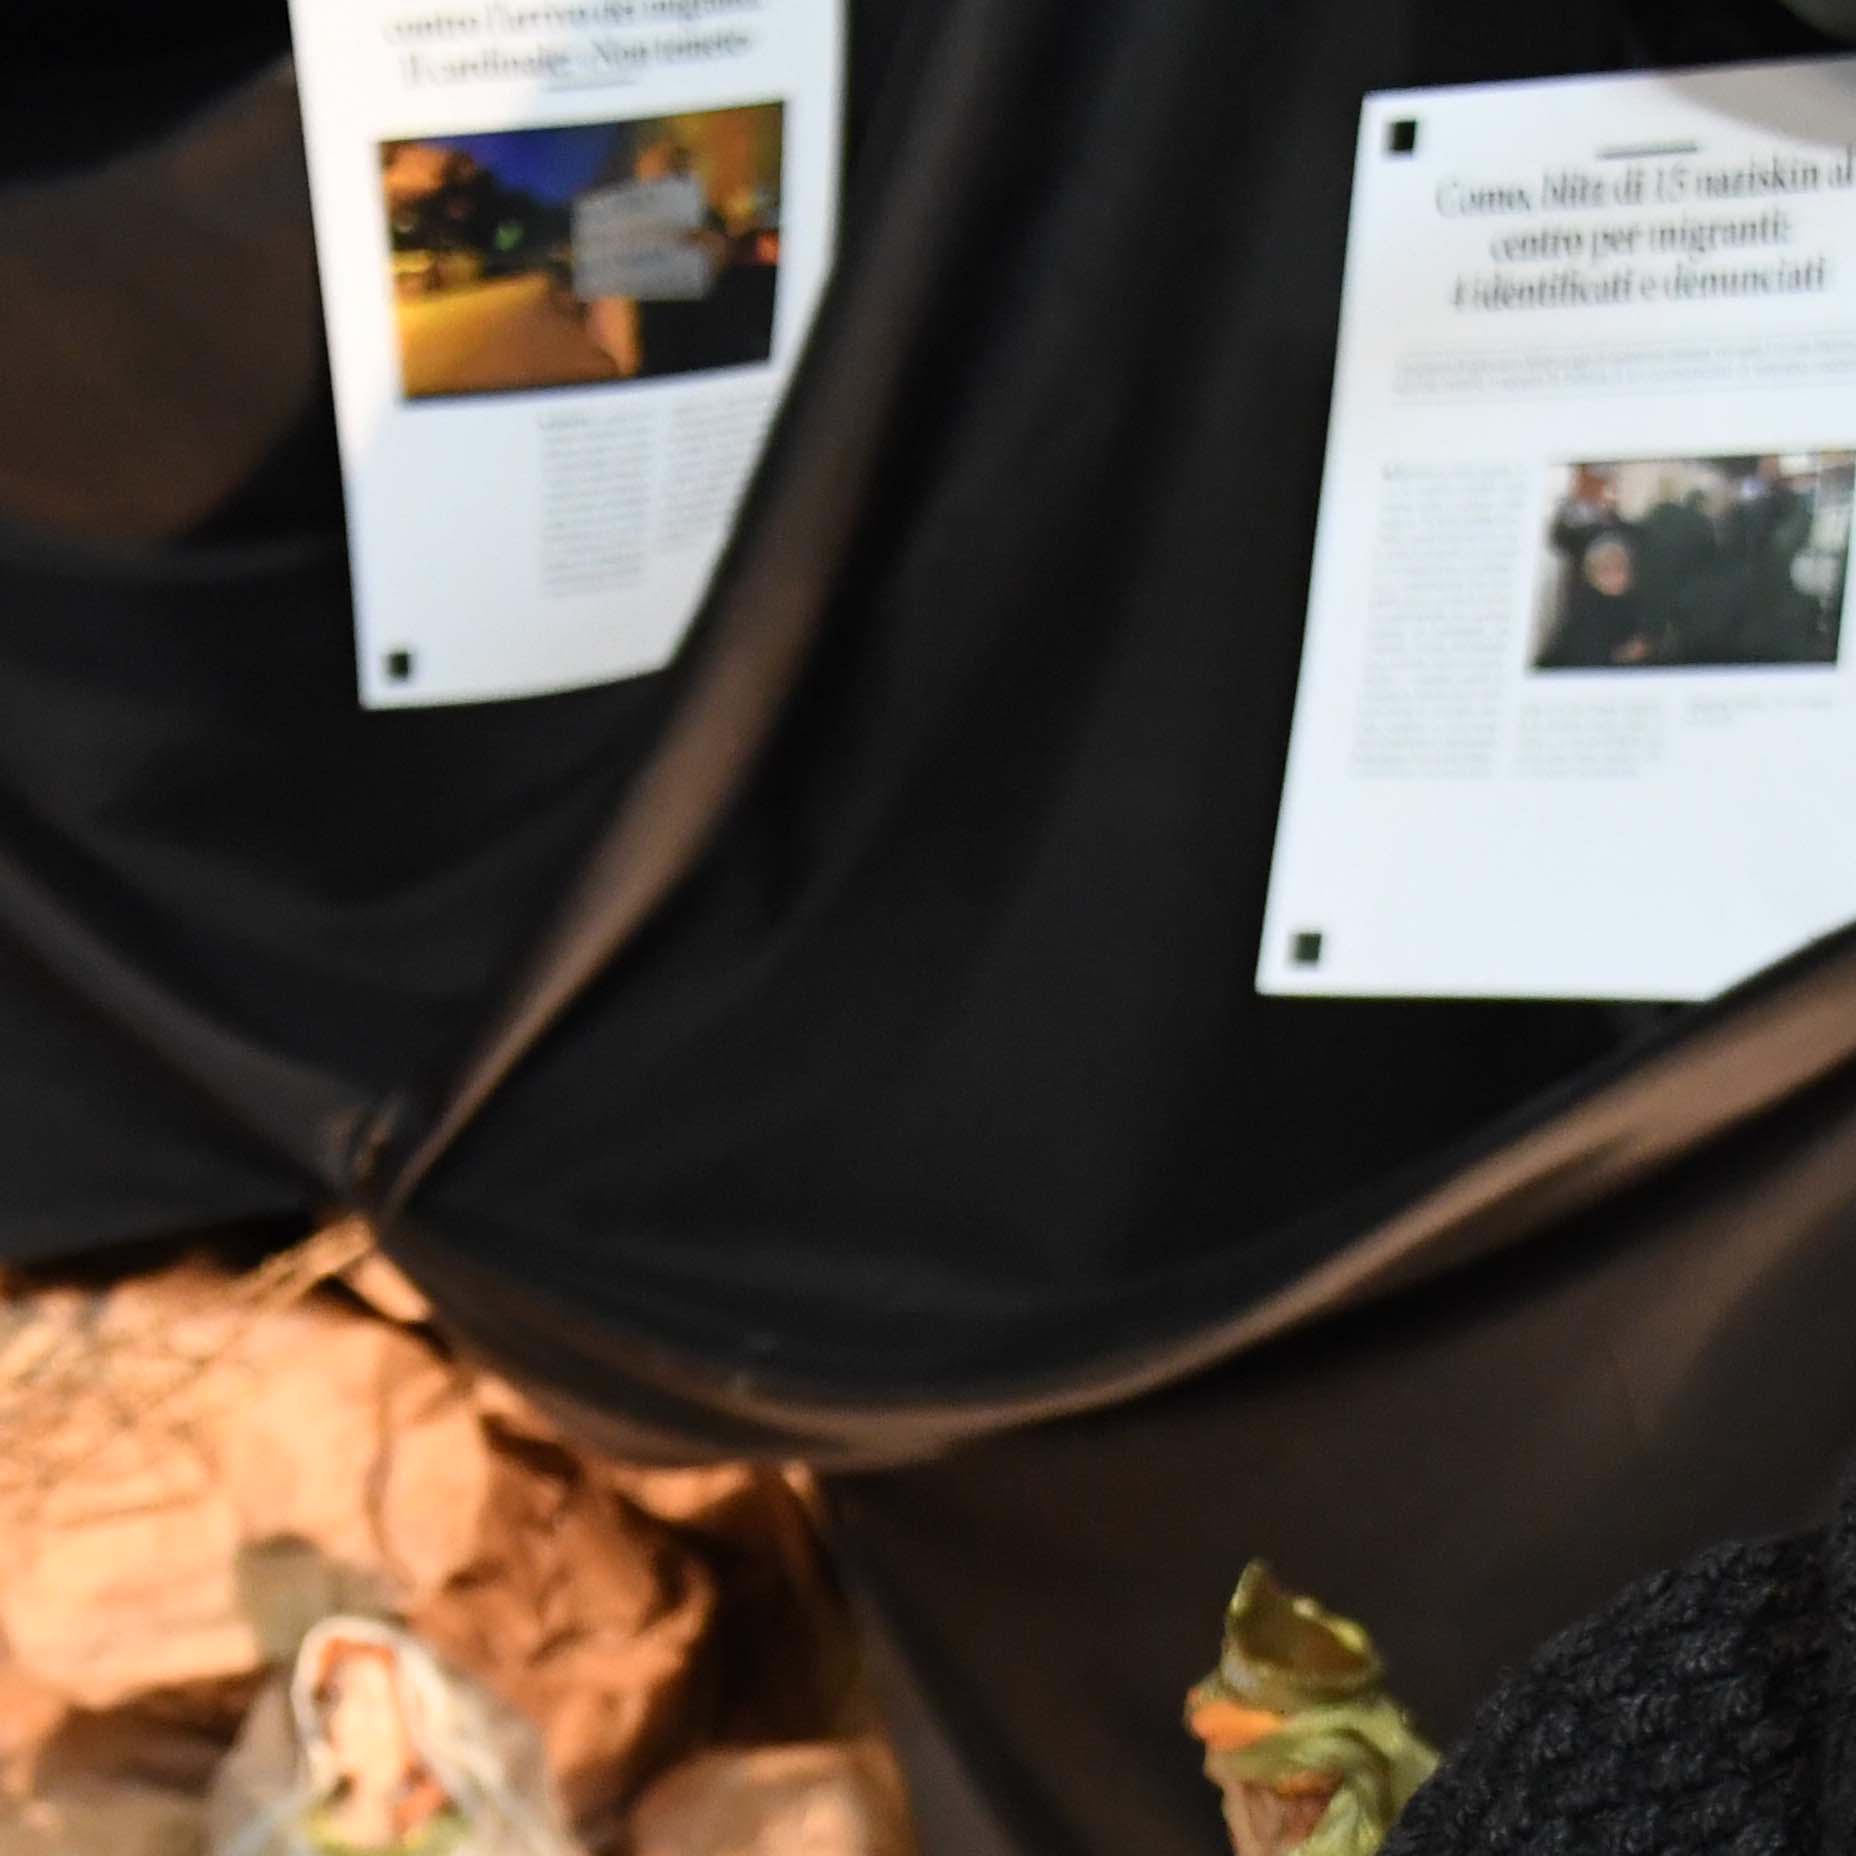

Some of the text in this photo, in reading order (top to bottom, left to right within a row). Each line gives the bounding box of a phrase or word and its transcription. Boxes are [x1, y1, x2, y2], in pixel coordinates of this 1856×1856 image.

[1613, 164, 1647, 206] di
[1696, 152, 1821, 200] naziskin
[1828, 143, 1856, 190] al
[1489, 223, 1584, 262] centro
[1589, 222, 1642, 269] per
[1638, 271, 1659, 302] e
[1663, 254, 1829, 302] denunciati
